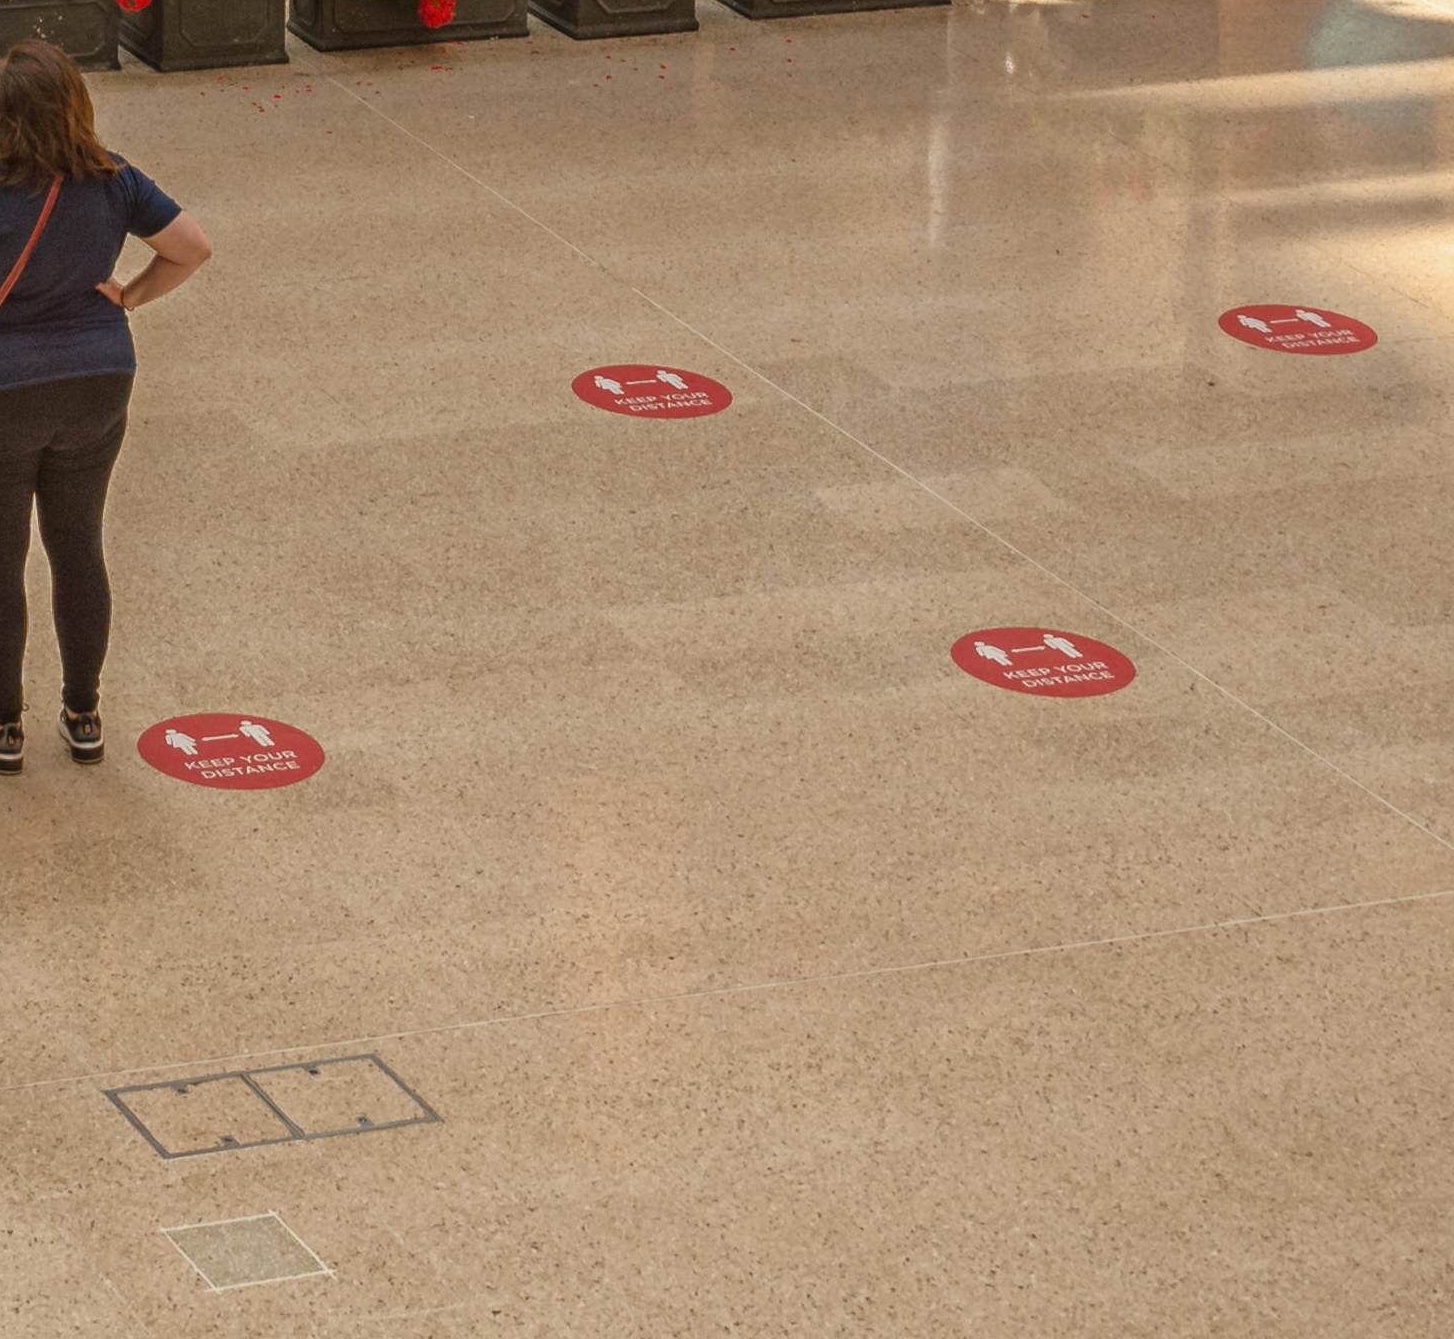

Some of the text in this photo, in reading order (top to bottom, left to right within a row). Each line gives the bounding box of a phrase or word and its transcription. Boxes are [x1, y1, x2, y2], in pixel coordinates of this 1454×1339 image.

[185, 750, 297, 770] KEEP YOUR
[201, 761, 300, 779] DISTANCE
